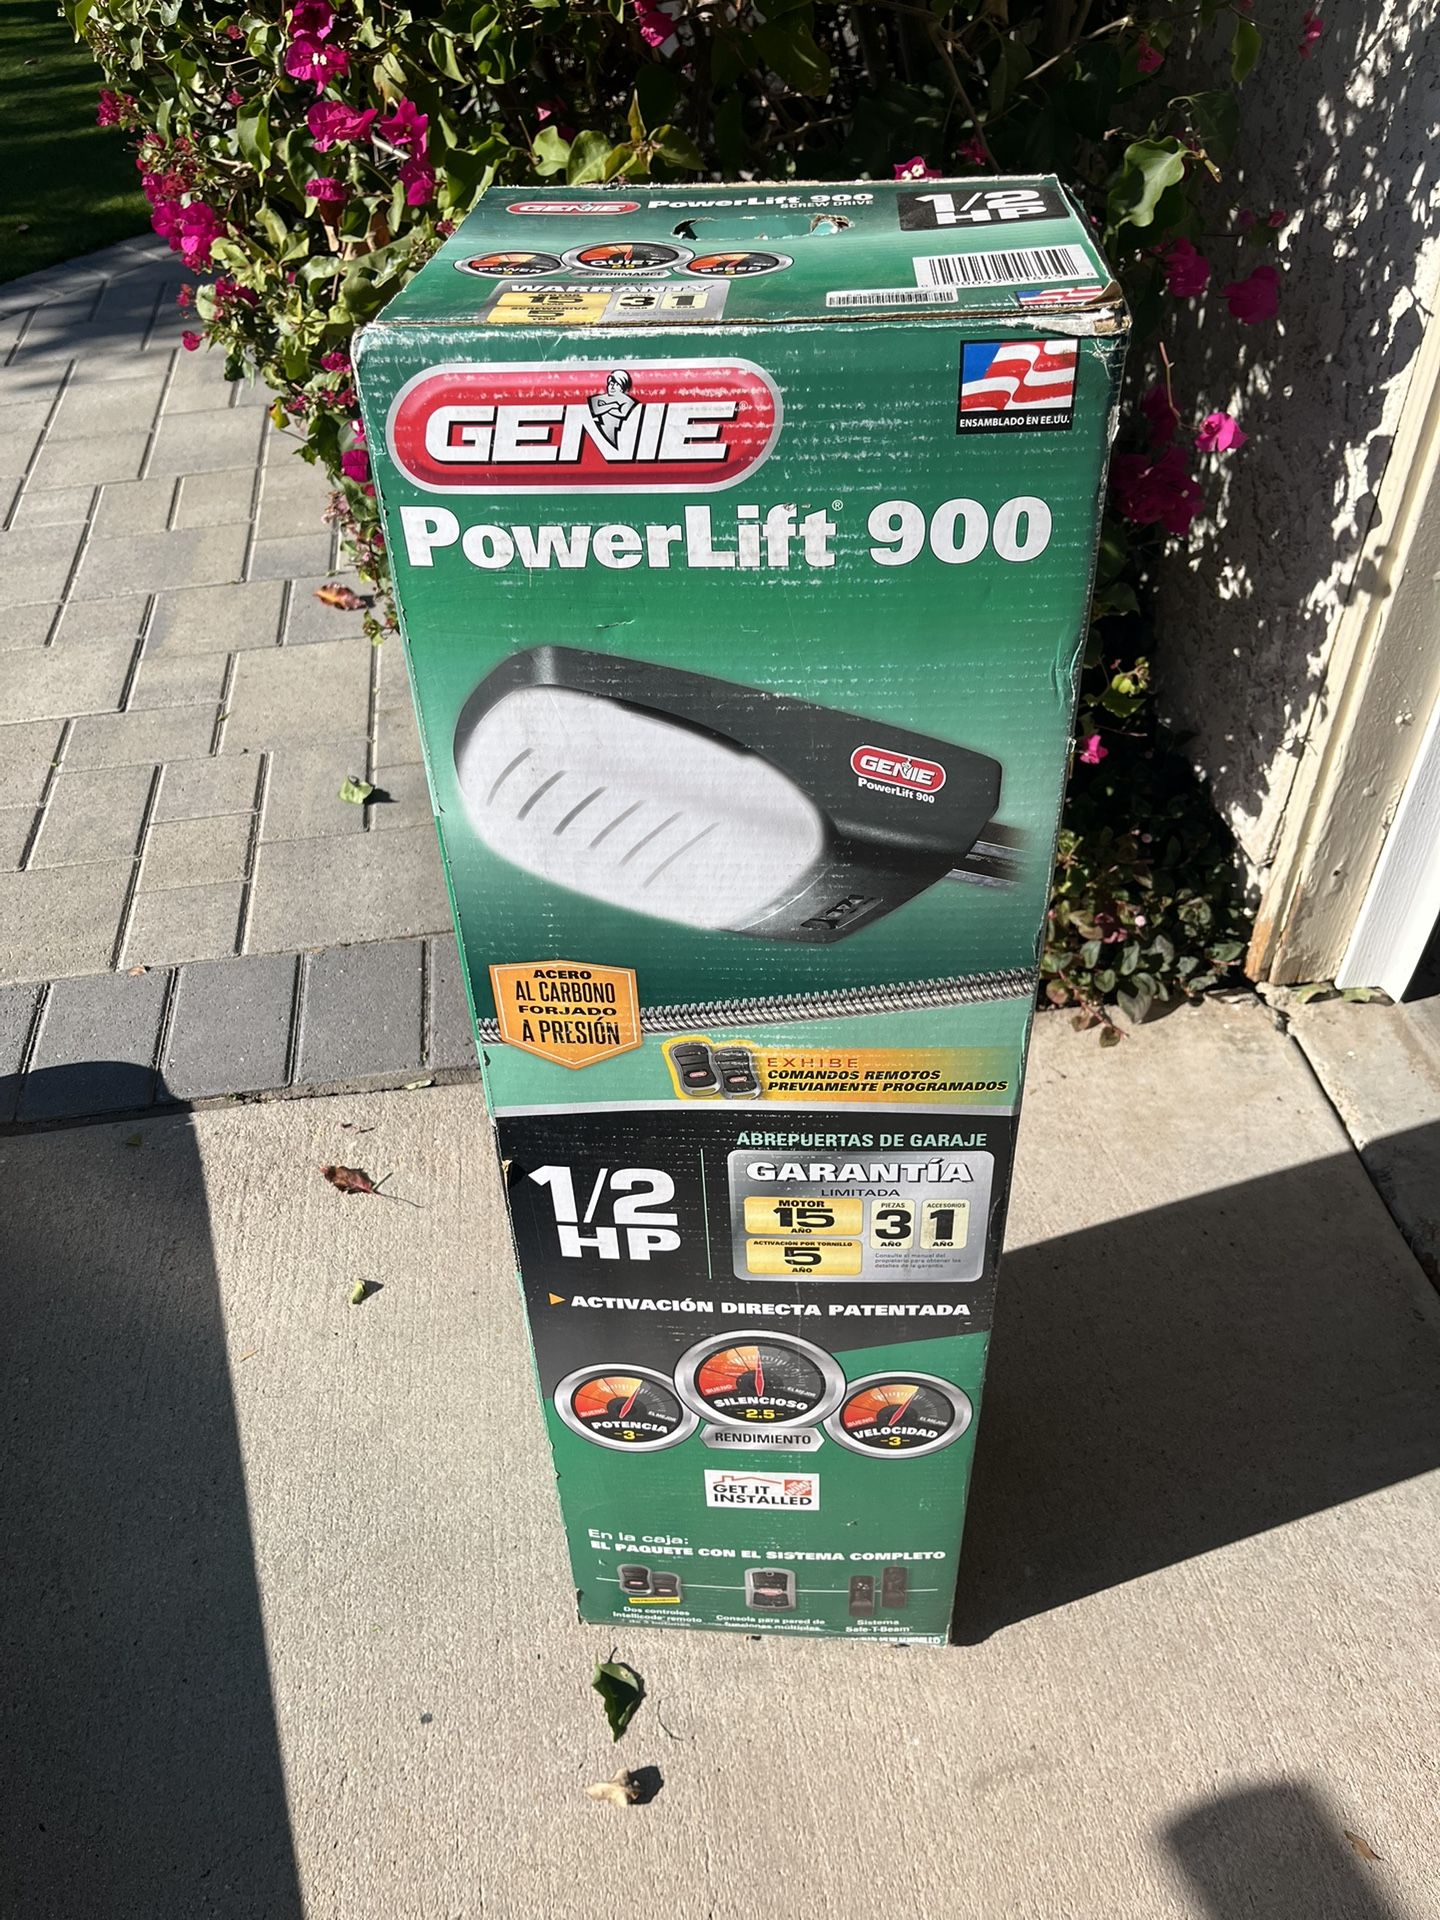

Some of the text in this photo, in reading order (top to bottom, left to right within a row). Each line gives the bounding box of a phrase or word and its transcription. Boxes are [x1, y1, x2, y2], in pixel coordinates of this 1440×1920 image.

[648, 193, 874, 209] PowerLift 900
[915, 189, 1045, 212] 1/2
[520, 204, 626, 212] GENIE
[935, 206, 1048, 225] HP
[511, 284, 715, 293] WARRANTY
[528, 295, 584, 304] 15
[620, 296, 656, 307] 3
[672, 295, 695, 306] 1
[959, 414, 1070, 428] ENSAMBLADO EN EE.UU.
[424, 401, 737, 463] GENIE
[867, 496, 1053, 567] 900
[860, 754, 936, 786] GENIE
[857, 777, 935, 804] PowerLift 900
[533, 969, 592, 980] ACERO
[515, 980, 616, 1004] AL CARBONO
[518, 1005, 617, 1016] FORJADO
[522, 1016, 621, 1045] A PRESIÓN
[767, 1057, 859, 1068] EXHIBE
[767, 1070, 941, 1080] COMANDOS REMOTOS
[767, 1081, 1008, 1092] PREVIAMENTE PROGRAMADOS
[736, 1132, 987, 1147] ABREPUERTAS DE GARAJE
[745, 1157, 974, 1183] GARANTÍA
[527, 1164, 679, 1226] 1/2
[821, 1188, 901, 1197] LIMITADA
[778, 1199, 825, 1208] MOTOR
[773, 1207, 835, 1228] 15
[875, 1209, 912, 1240] 3
[930, 1209, 955, 1241] 1
[557, 1225, 682, 1261] HP
[880, 1240, 902, 1248] AÑO
[932, 1240, 954, 1248] AÑO
[784, 1247, 822, 1266] 5
[791, 1266, 813, 1274] AÑO
[571, 1294, 971, 1316] ACTIVACIÓN DIRECTA PATENTADA
[713, 1396, 808, 1411] SILENCIOSO
[745, 1409, 776, 1419] 2.5
[591, 1421, 668, 1434] POTENCIA
[853, 1427, 938, 1439] VELOCIDAD
[622, 1430, 636, 1440] 3
[714, 1432, 811, 1445] RENDIMIENTO
[888, 1436, 901, 1446] 3
[713, 1484, 770, 1494] GET IT
[714, 1494, 812, 1506] INSTALLED
[588, 1529, 689, 1545] En la caja:
[591, 1540, 946, 1561] EL PAQUETE CON EL SISTEMA COMPLETO
[644, 1608, 690, 1616] controles
[716, 1614, 756, 1622] Consola
